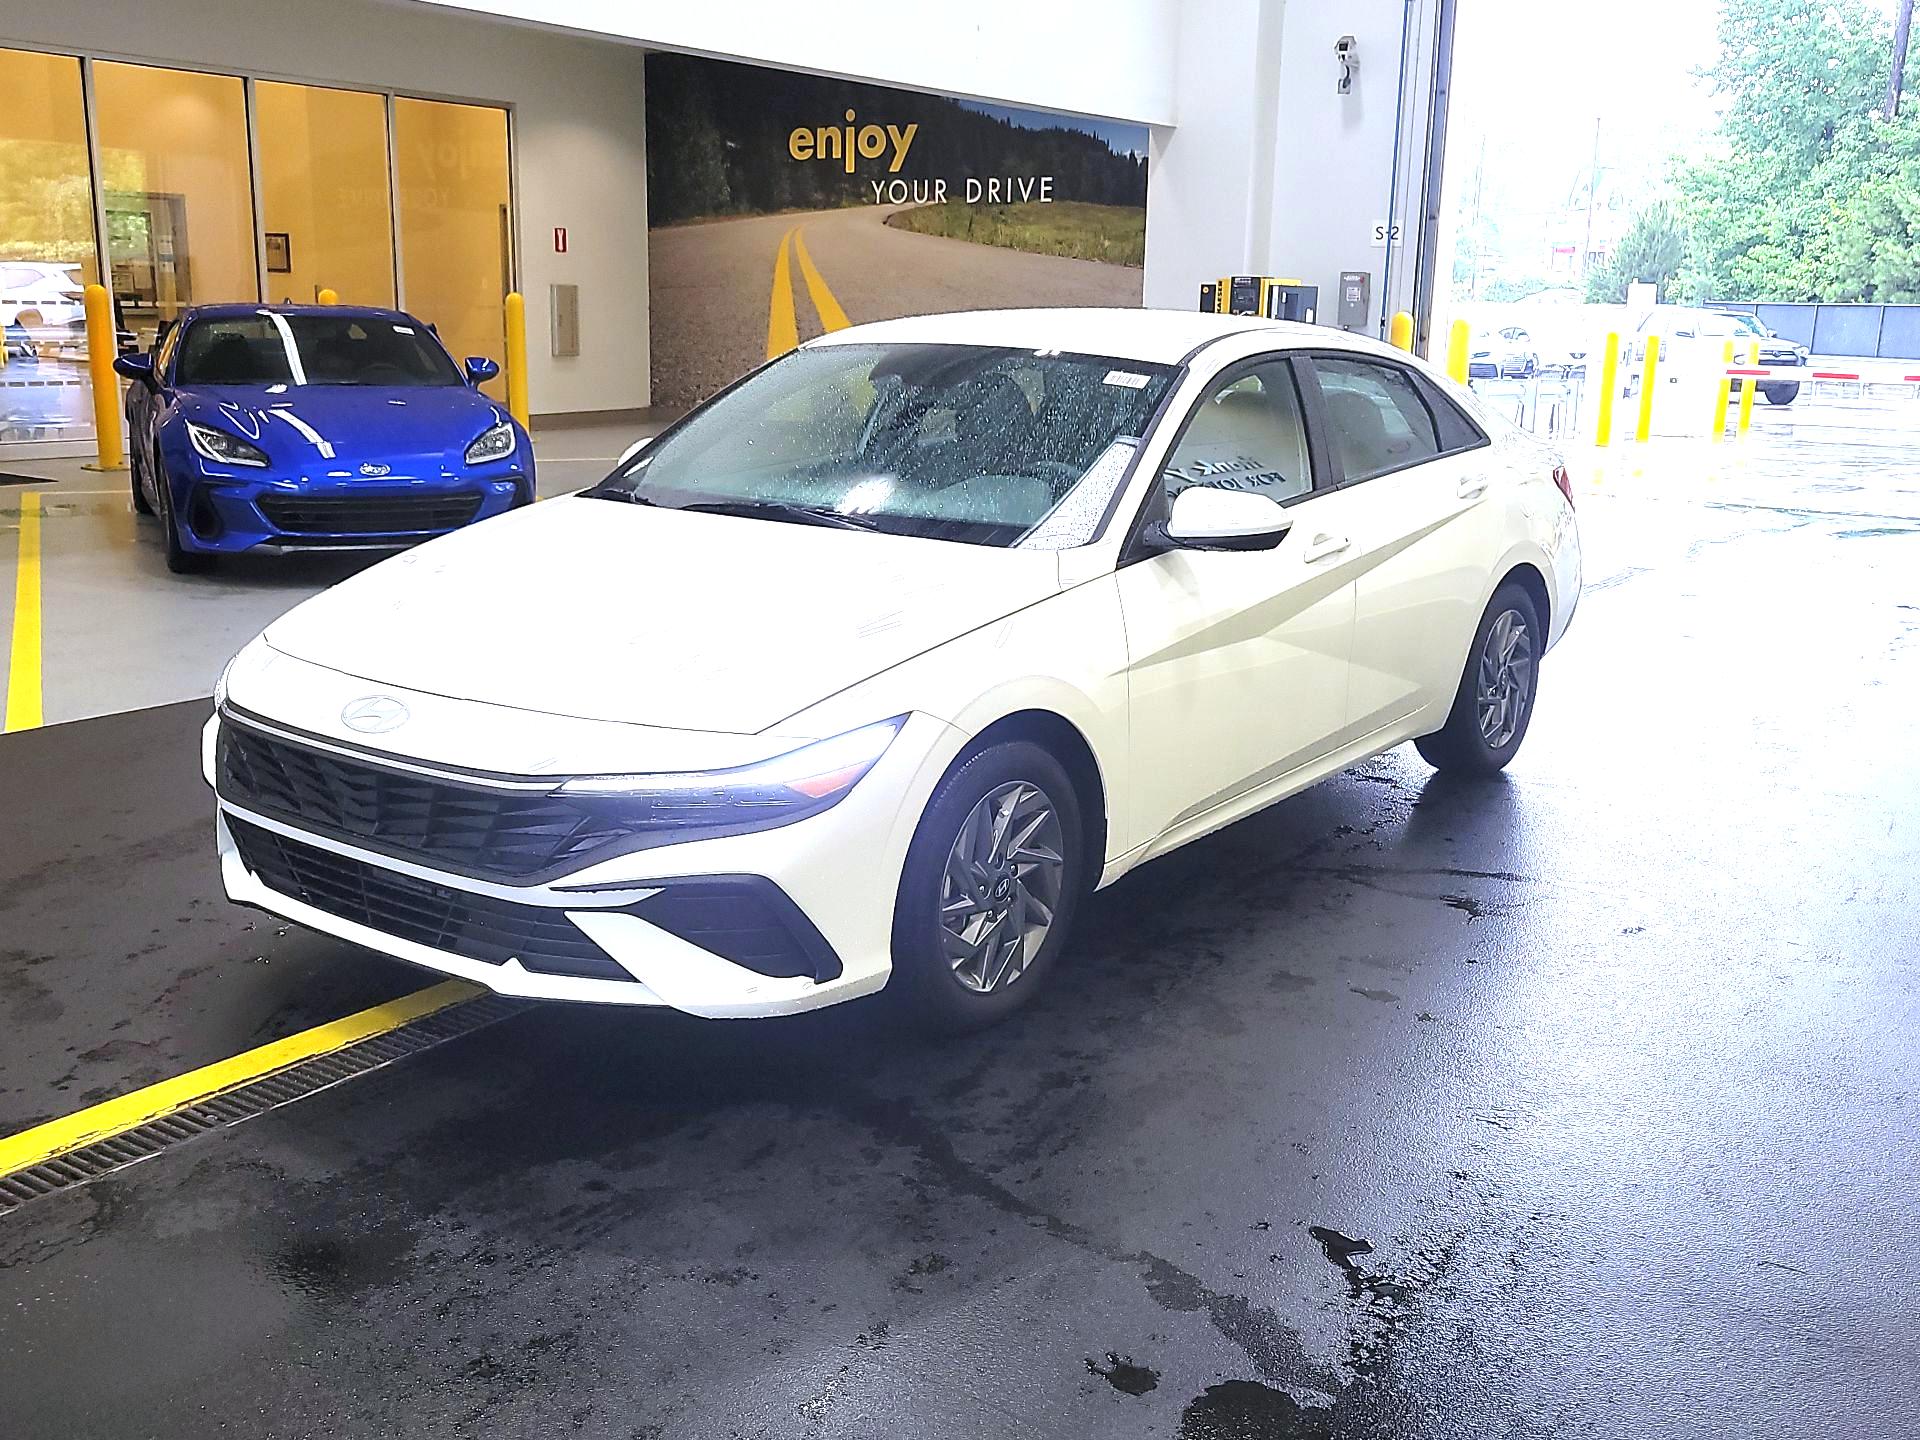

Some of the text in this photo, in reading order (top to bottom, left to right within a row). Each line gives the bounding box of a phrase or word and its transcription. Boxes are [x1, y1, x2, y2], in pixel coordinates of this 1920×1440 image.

[789, 108, 919, 173] enjoy
[871, 176, 1053, 204] YOUR DRIVE
